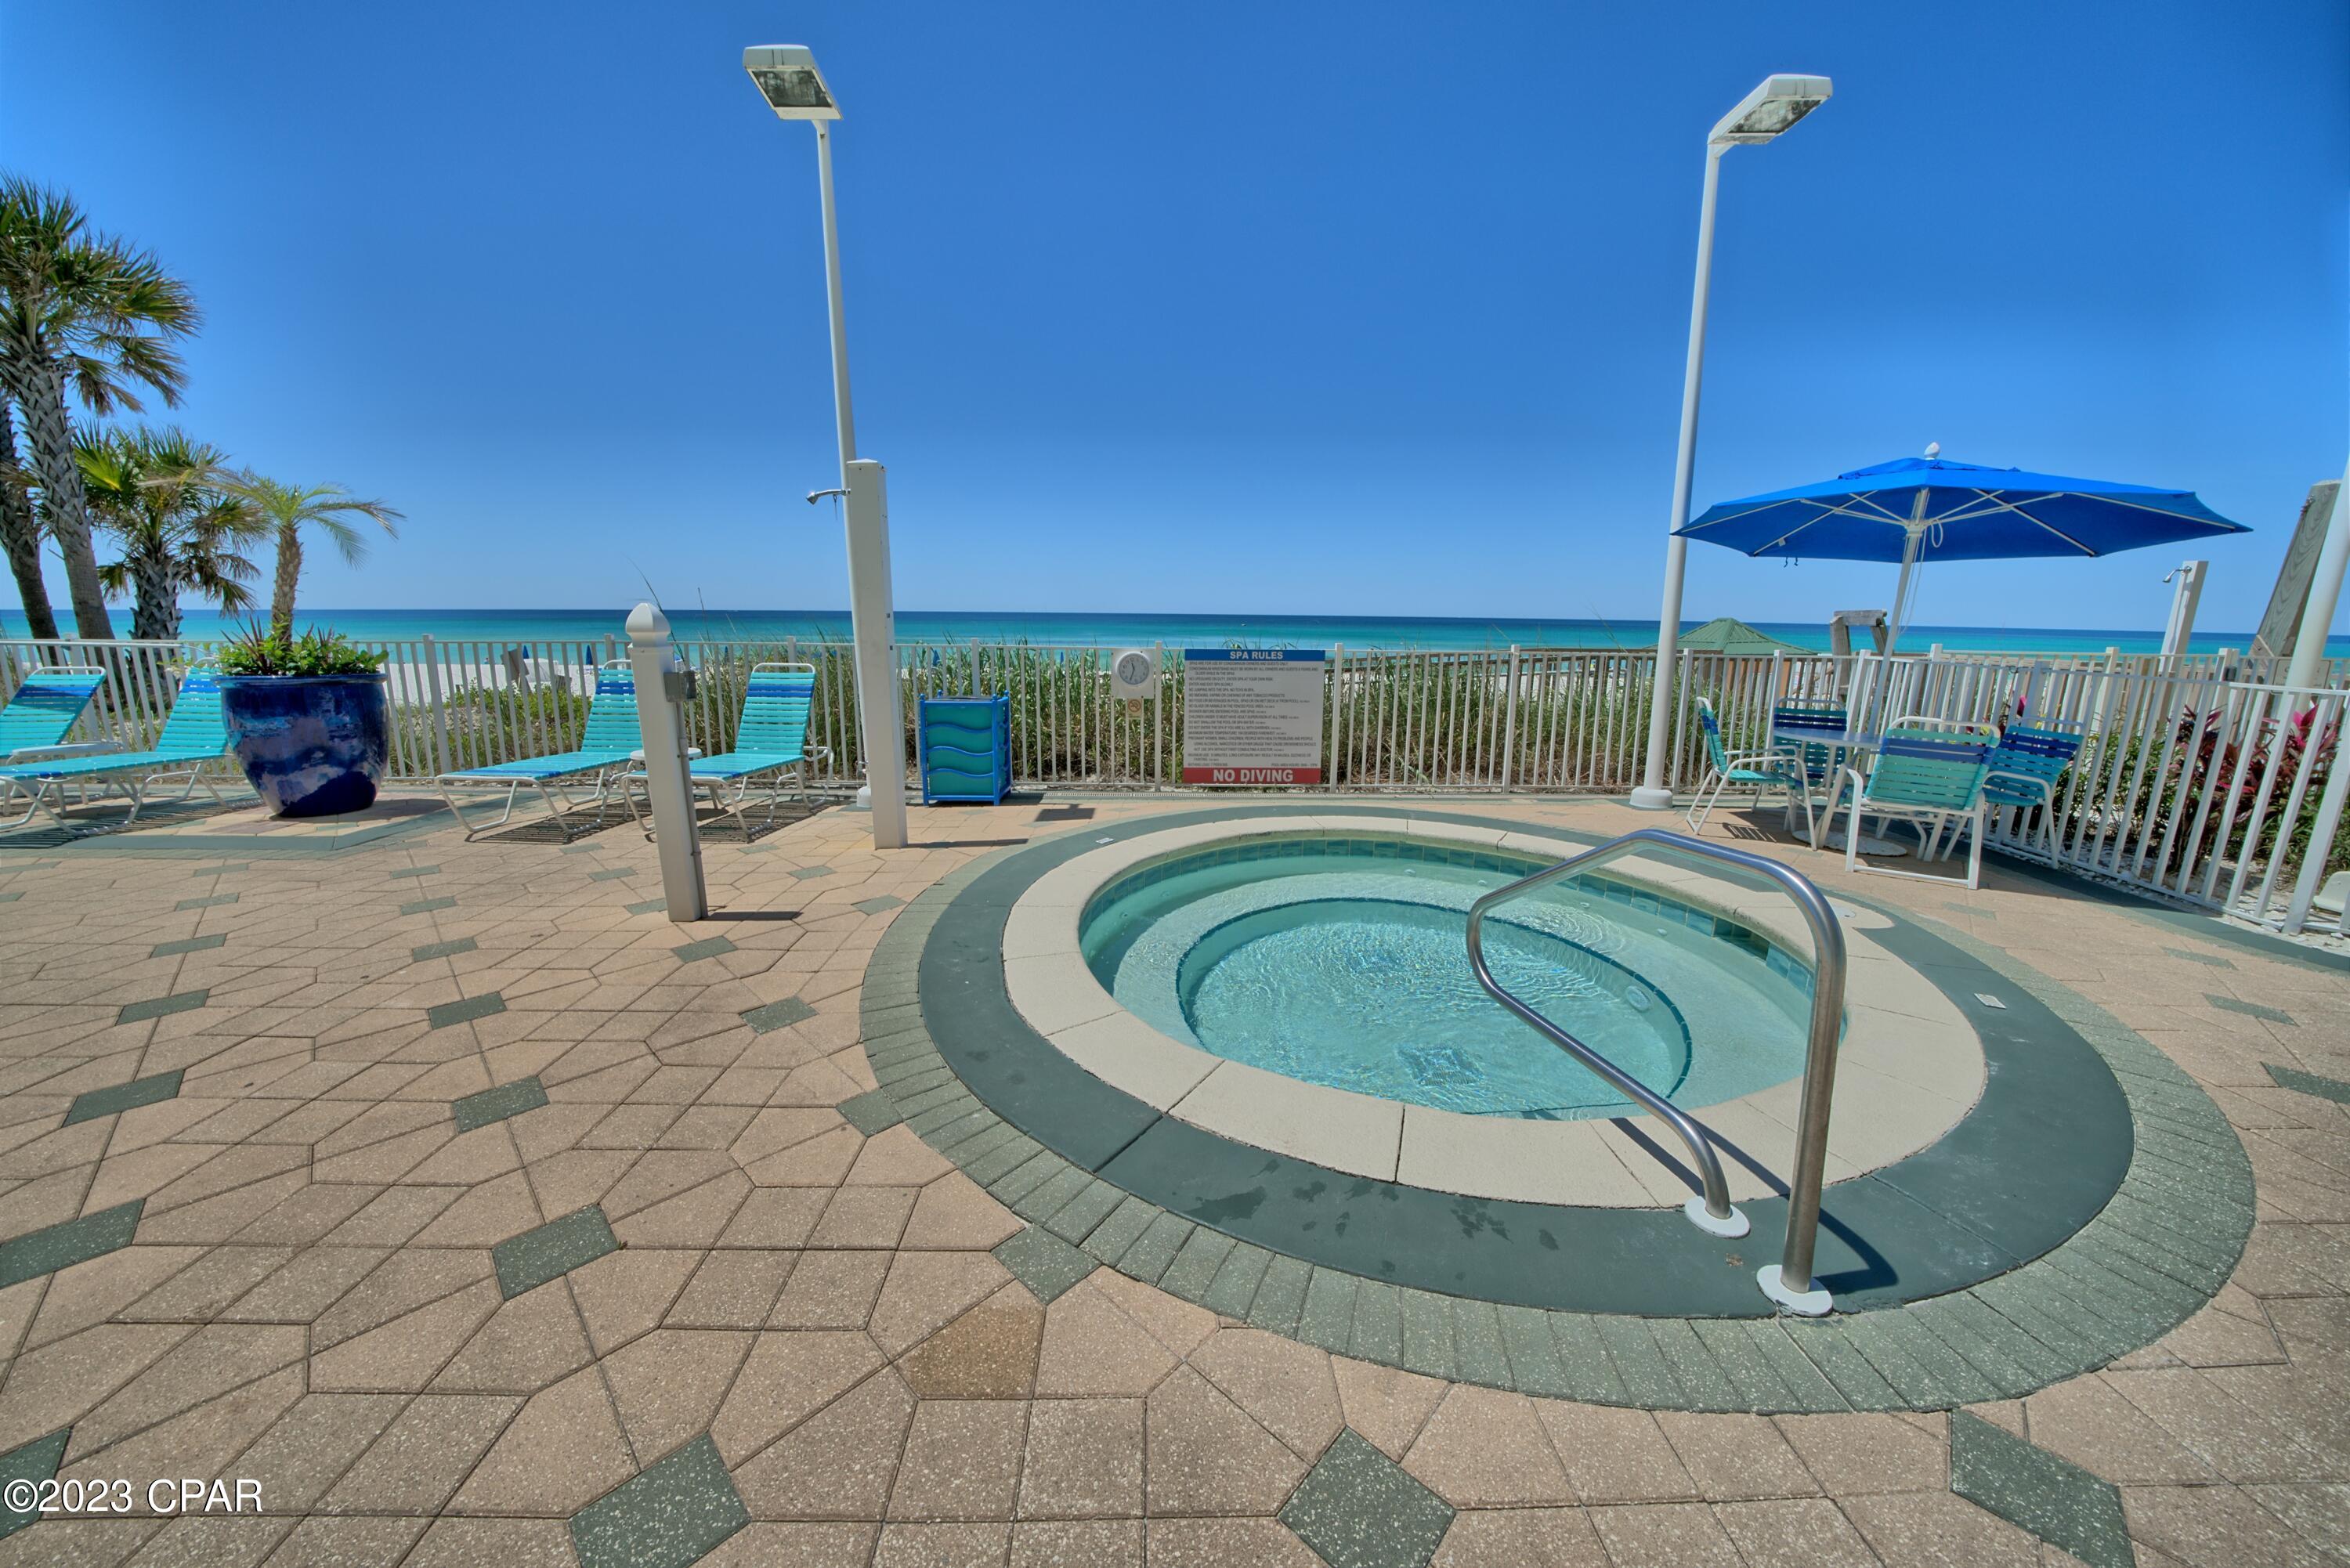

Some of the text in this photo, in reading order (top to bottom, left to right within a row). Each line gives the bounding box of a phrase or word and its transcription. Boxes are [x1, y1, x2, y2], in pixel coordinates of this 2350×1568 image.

[1230, 651, 1283, 659] SPA RULES
[1213, 770, 1293, 782] NO DIVING
